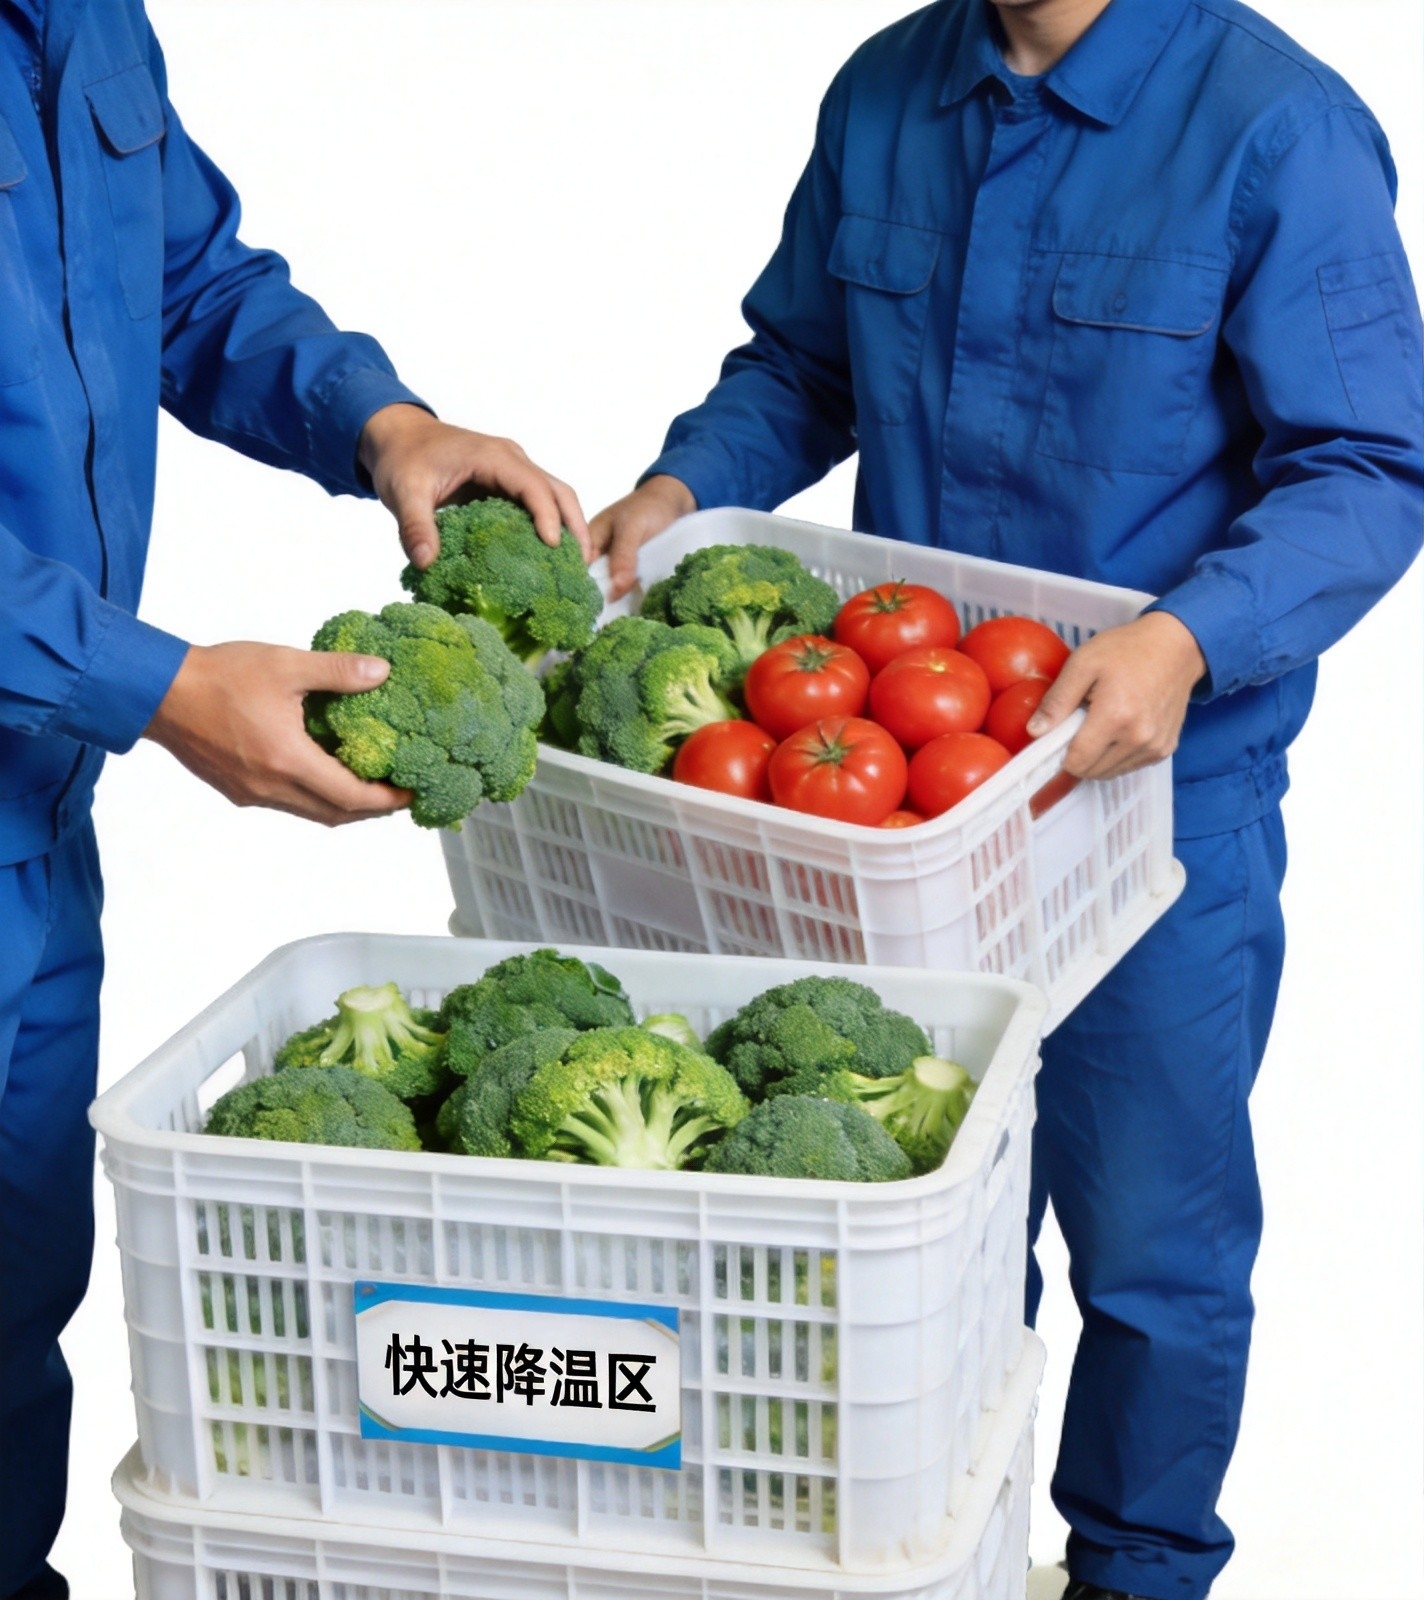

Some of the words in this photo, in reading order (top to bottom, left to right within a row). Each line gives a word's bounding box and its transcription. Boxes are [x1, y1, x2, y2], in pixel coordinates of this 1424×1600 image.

[384, 1332, 657, 1413] 快速降温区
